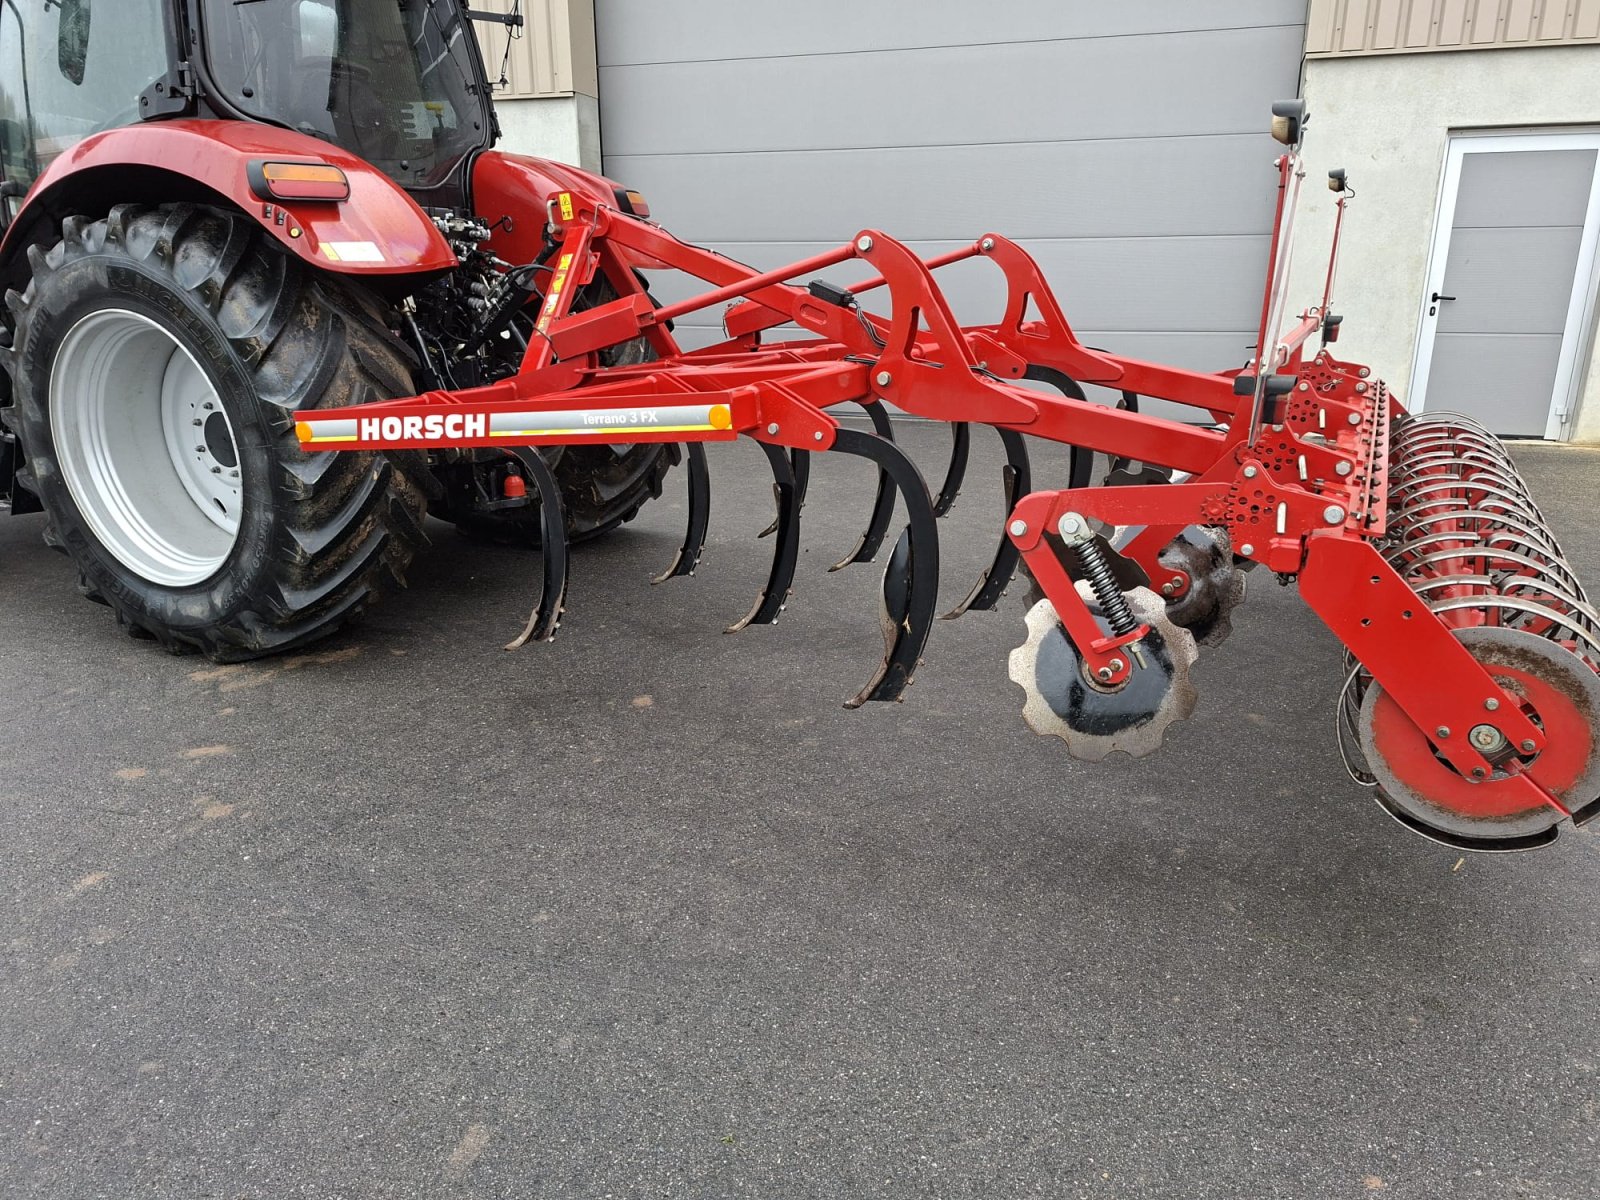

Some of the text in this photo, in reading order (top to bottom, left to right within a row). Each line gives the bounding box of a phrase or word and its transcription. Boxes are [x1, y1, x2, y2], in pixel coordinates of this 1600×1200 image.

[361, 413, 486, 441] HORSCH
[581, 410, 658, 425] Terrano 3 FX
